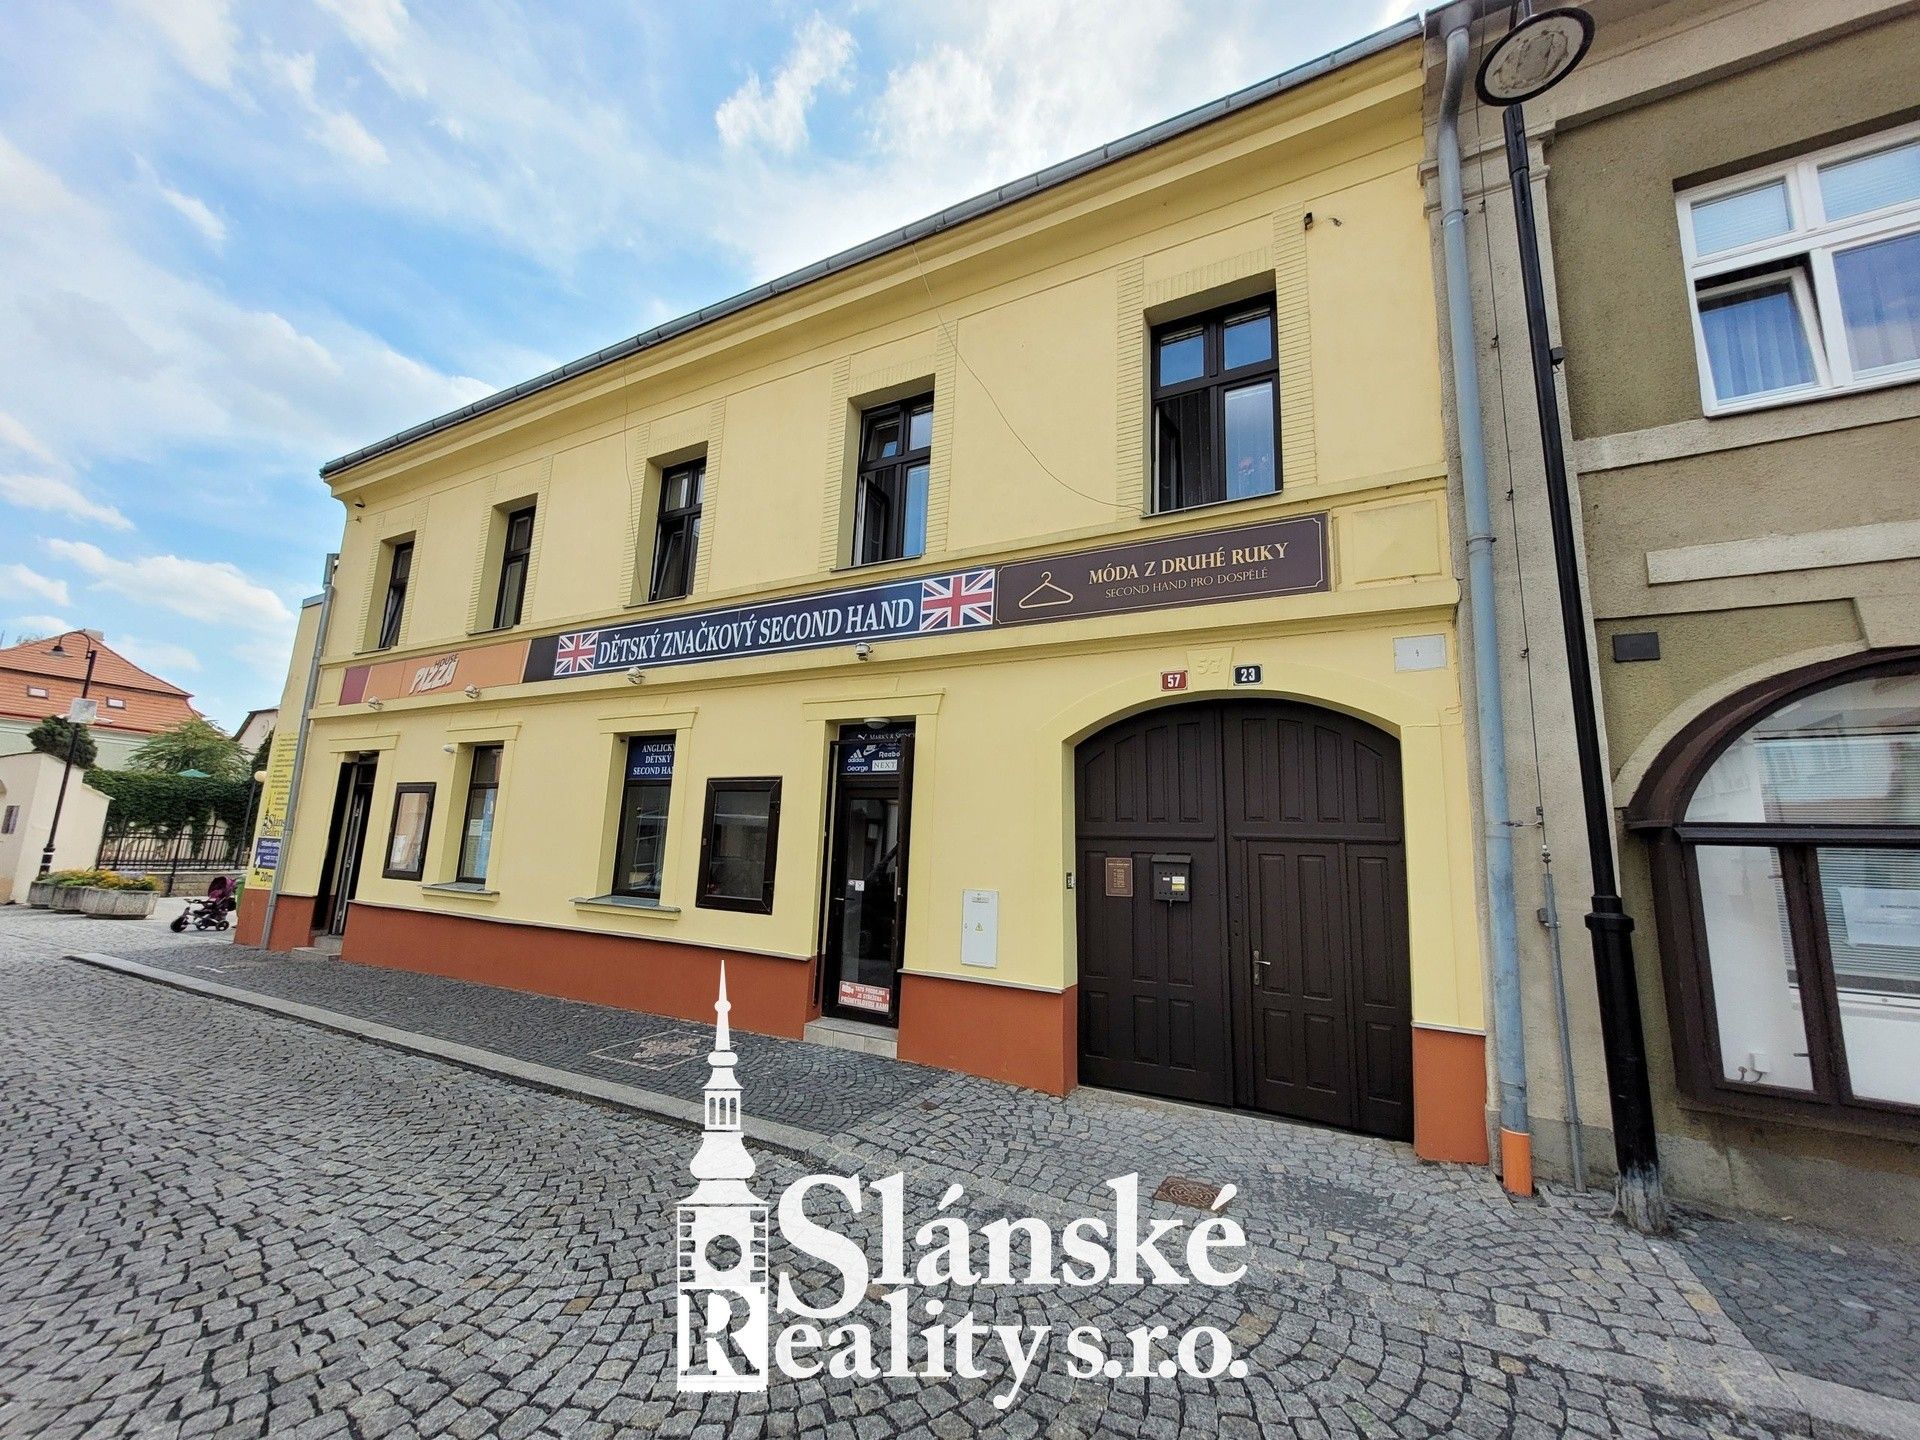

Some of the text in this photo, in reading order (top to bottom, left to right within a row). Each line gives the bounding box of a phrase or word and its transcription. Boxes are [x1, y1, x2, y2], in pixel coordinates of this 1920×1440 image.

[1088, 542, 1289, 585] MÓDA Z DRUHÉ RUKY
[1105, 567, 1269, 599] SECOND HAND PRO DOSPĚLÉ
[598, 598, 914, 665] DĚTSKÝ ZNAČKOVÝ SECOND HAND
[433, 653, 459, 668] HOUSE
[409, 659, 460, 695] PIZZA
[1167, 674, 1181, 688] 57
[1240, 668, 1256, 682] 23
[645, 752, 672, 764] DĚTSKÝ
[878, 750, 901, 758] Reebo
[632, 766, 661, 776] SECOND
